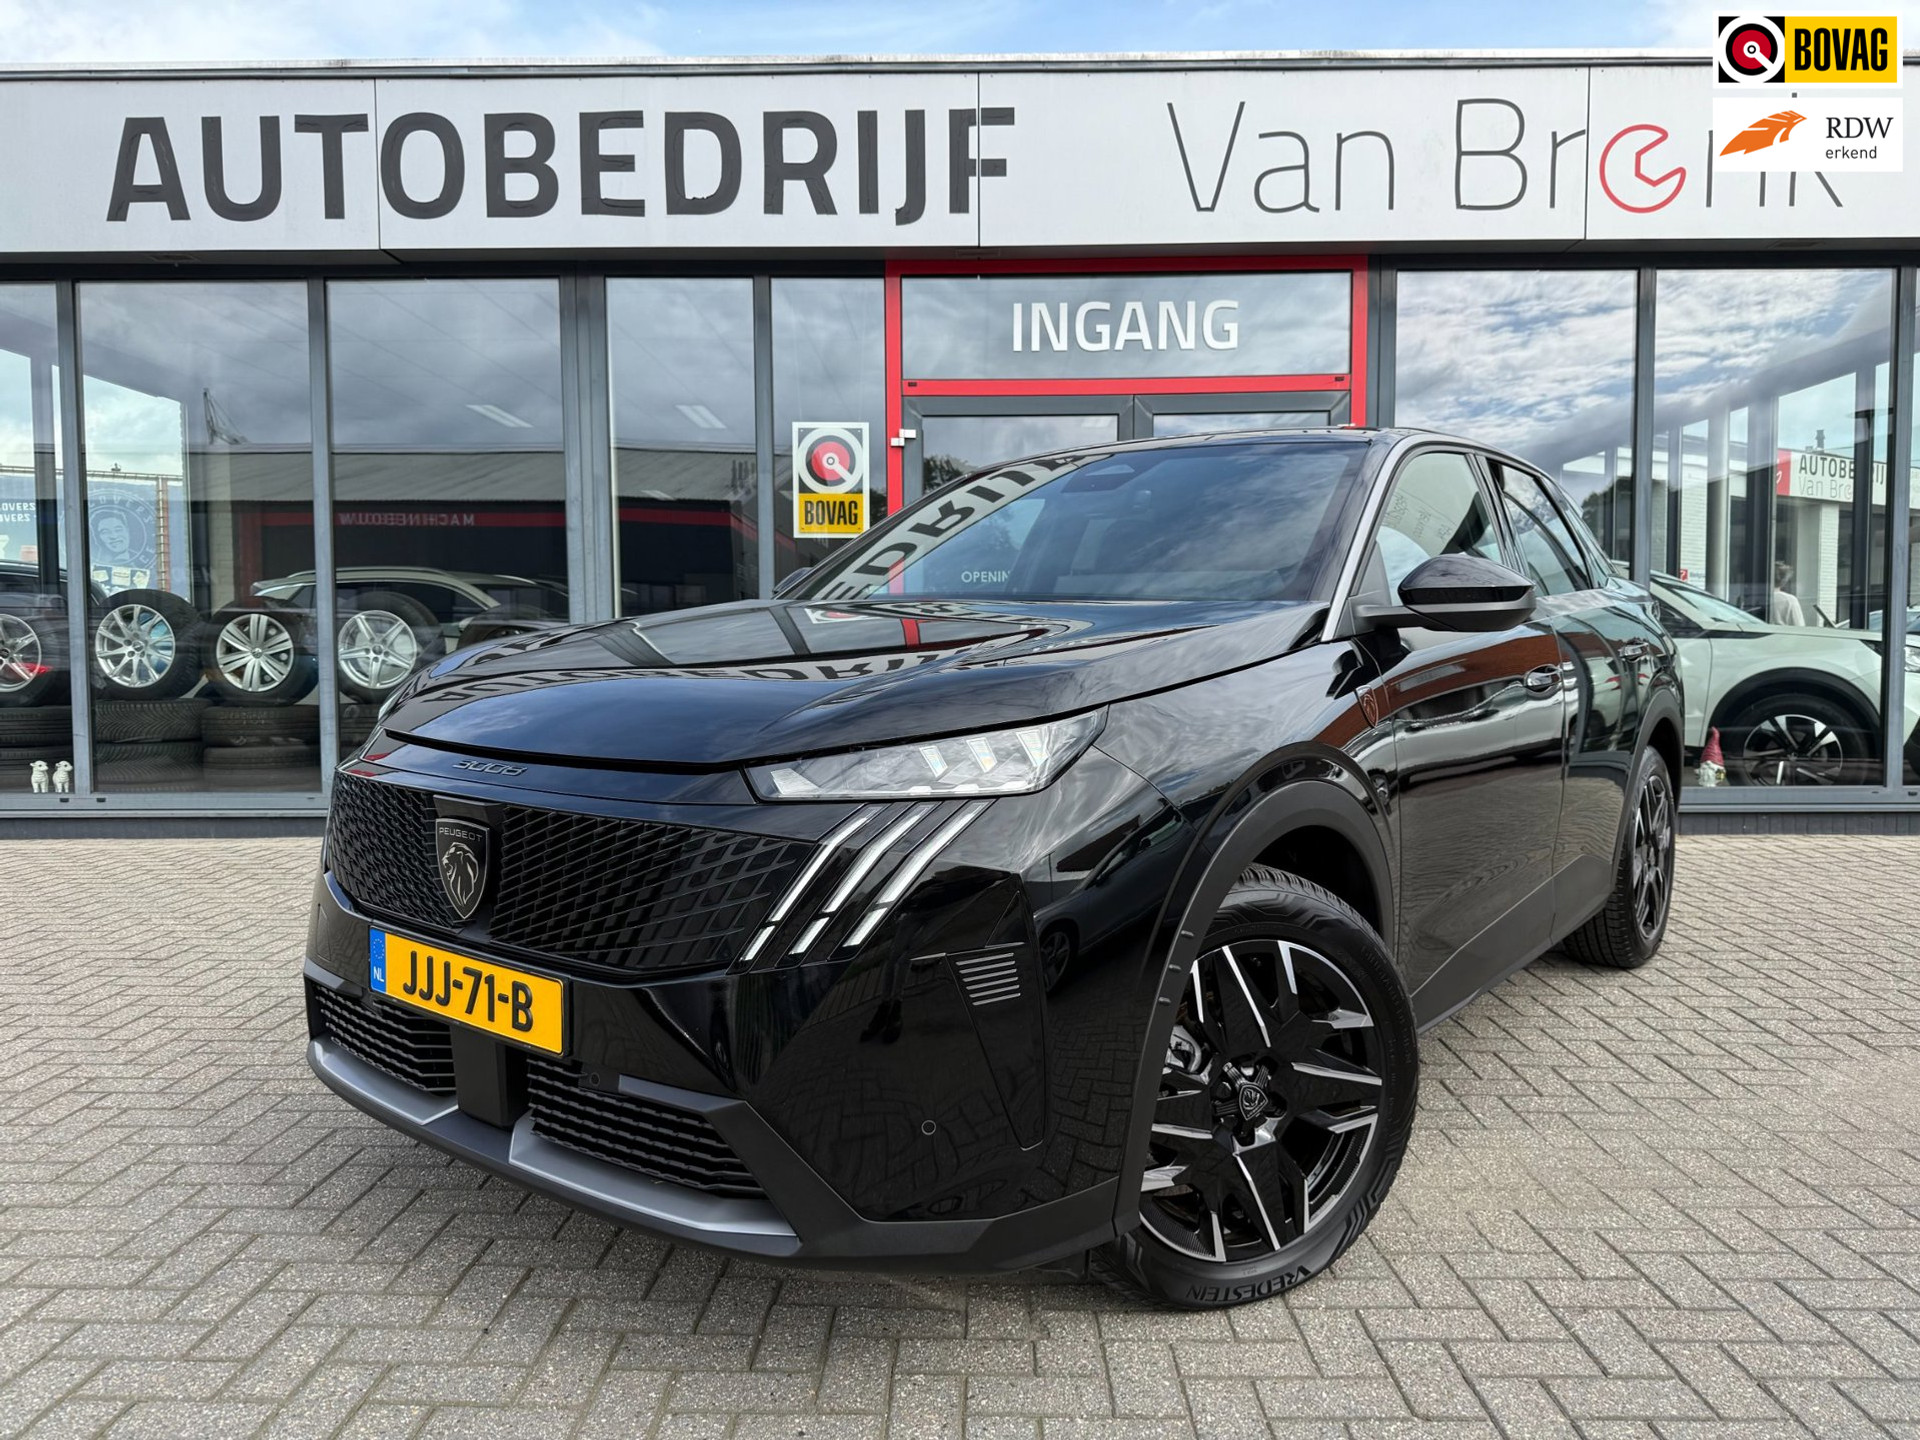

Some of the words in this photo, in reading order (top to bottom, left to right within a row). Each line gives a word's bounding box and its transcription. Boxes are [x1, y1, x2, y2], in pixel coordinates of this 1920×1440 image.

[106, 107, 1015, 226] AUTOBEDRIJF
[1167, 100, 1395, 213] Van
[1013, 300, 1239, 351] INGANG
[1799, 476, 1824, 496] Van
[804, 500, 858, 525] BOVAG
[452, 760, 528, 776] 3008
[438, 826, 483, 841] PEUGEOT
[373, 966, 385, 982] NL
[403, 951, 533, 1032] JJJ-71-B
[1186, 1265, 1312, 1301] VREDESTEIN
